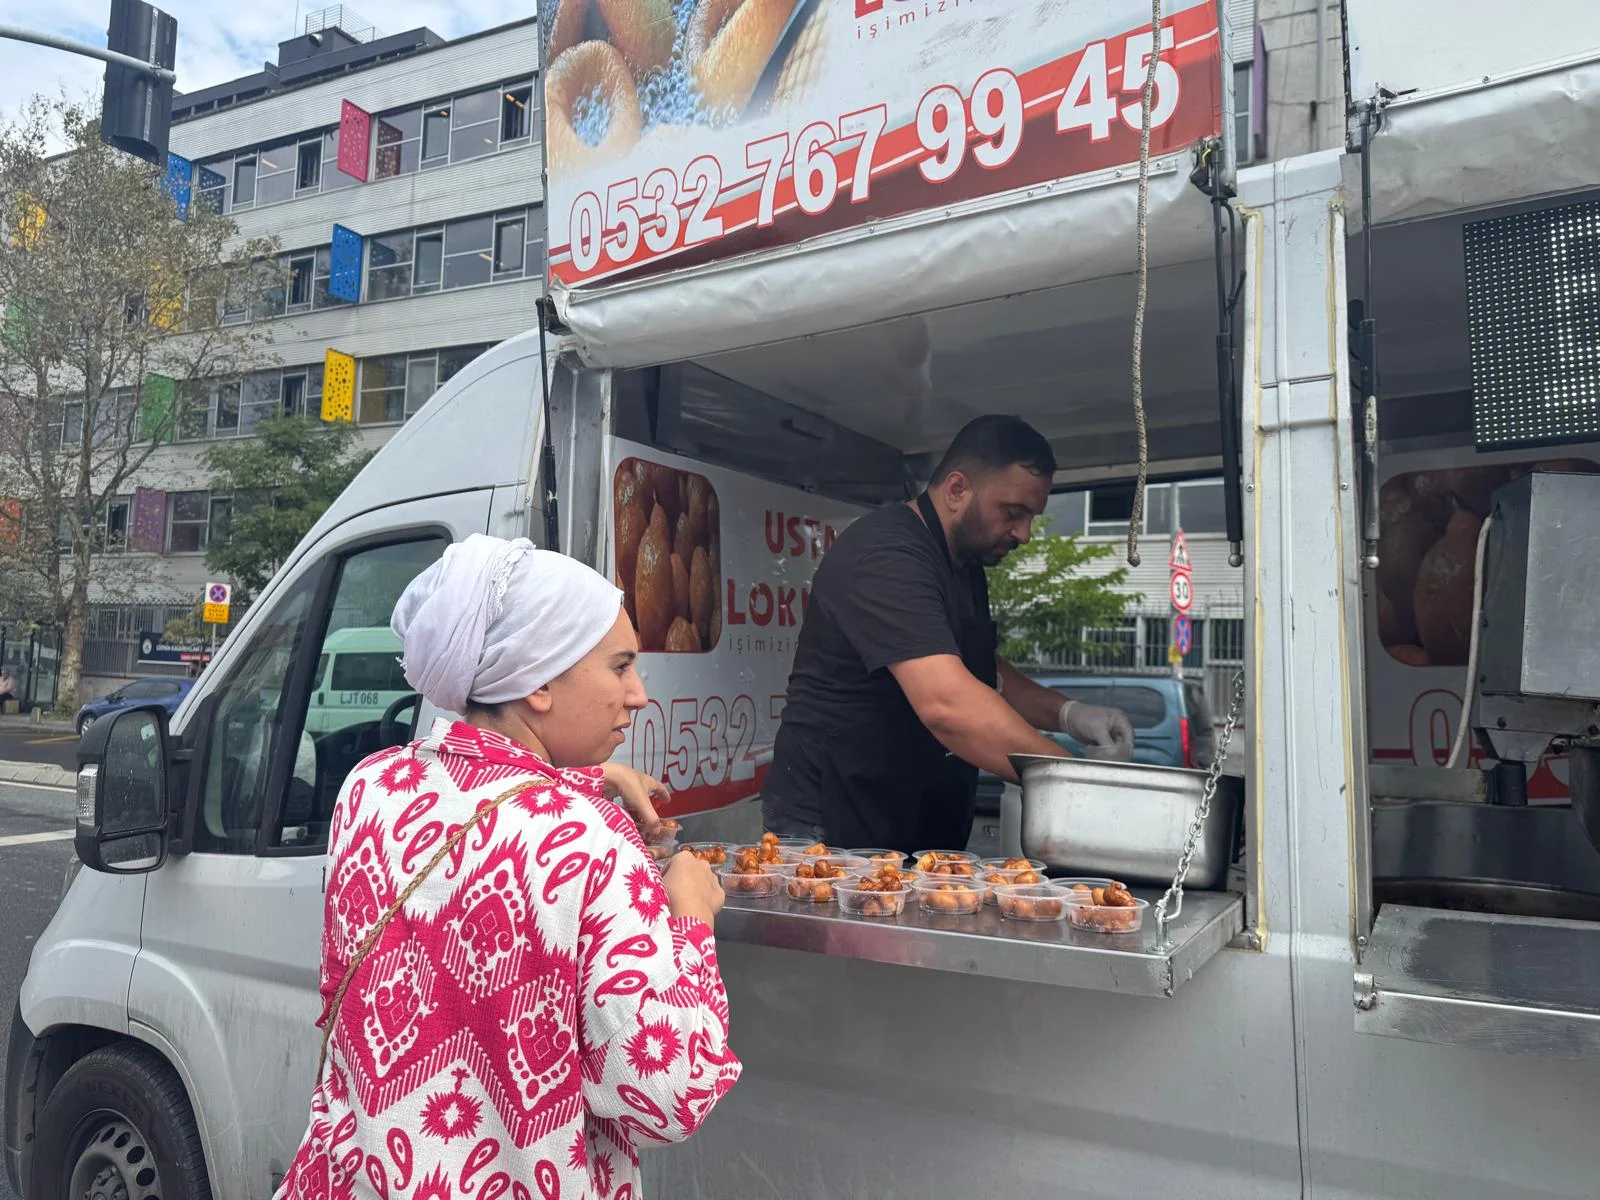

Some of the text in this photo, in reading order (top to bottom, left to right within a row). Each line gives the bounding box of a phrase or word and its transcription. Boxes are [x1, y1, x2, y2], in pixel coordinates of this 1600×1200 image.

[569, 26, 1181, 272] 0532 767 99 45
[1175, 582, 1188, 599] 30
[632, 694, 757, 792] 0532
